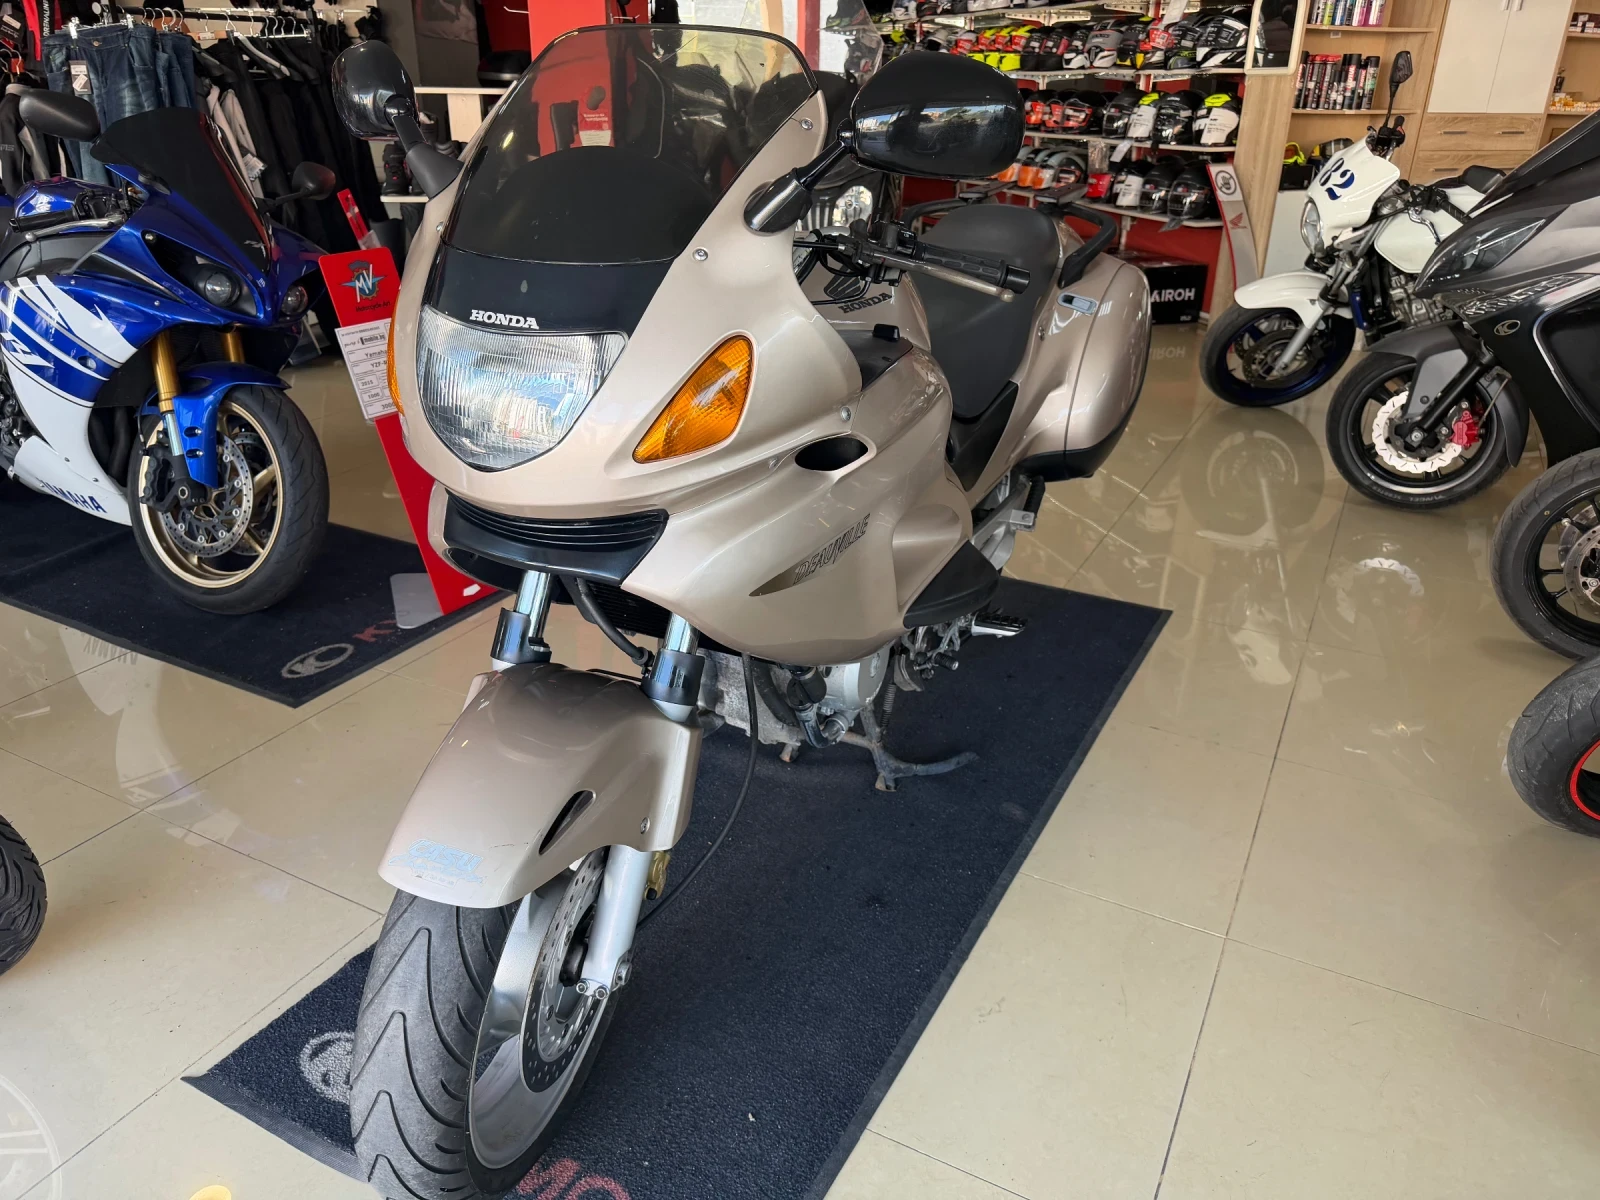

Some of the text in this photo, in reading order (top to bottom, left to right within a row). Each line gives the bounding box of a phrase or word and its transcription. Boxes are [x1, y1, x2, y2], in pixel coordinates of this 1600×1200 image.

[838, 292, 893, 314] HONDA
[1150, 288, 1195, 303] AIROH
[469, 309, 540, 330] HONDA
[35, 477, 108, 514] YAMAHA
[792, 513, 871, 586] DEAUVILLE
